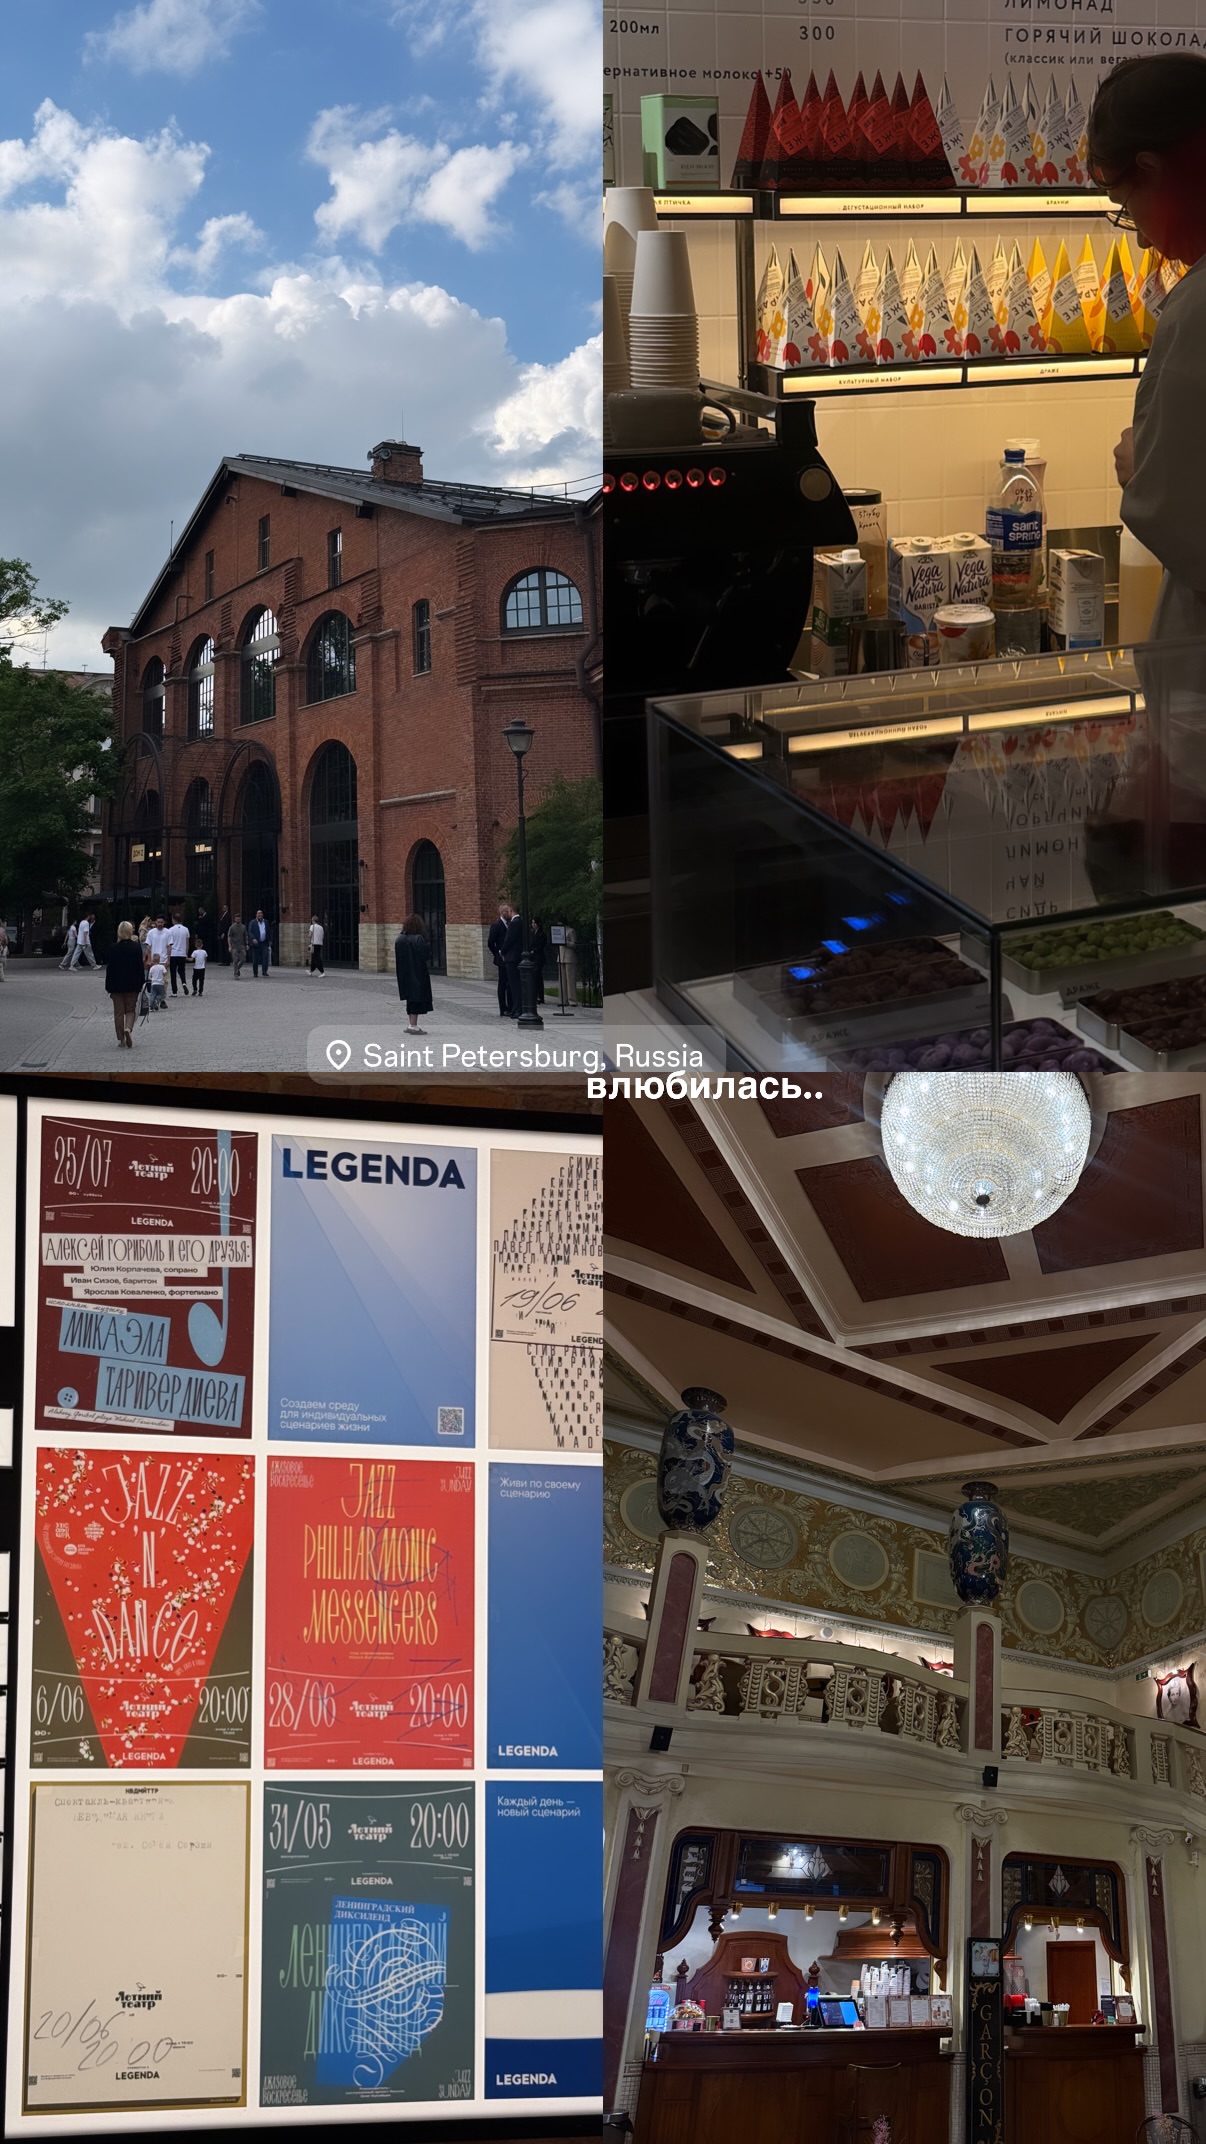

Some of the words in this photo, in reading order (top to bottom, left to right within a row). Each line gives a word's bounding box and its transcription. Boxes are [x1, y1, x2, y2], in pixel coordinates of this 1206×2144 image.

[610, 20, 659, 34] 200мл
[799, 26, 835, 40] 300
[1005, 27, 1101, 44] ГОРЯЧИЙ
[1112, 31, 1206, 46] ШОКОЛА
[1005, 52, 1064, 65] (классик
[1070, 56, 1094, 64] или
[603, 67, 697, 80] ернативное
[1008, 531, 1041, 542] SPRING
[911, 563, 943, 582] Vega
[956, 558, 988, 579] Vega
[905, 579, 947, 604] Natura
[952, 575, 992, 600] Natura
[914, 602, 940, 610] BARISTA
[54, 1134, 113, 1189] 25/07
[128, 1160, 174, 1173] Летний
[134, 1171, 168, 1181] театр
[191, 1147, 240, 1197] 20:00
[283, 1148, 466, 1190] LEGENDA
[131, 1217, 174, 1228] LEGENDA
[494, 1240, 531, 1254] ПАВЕЛ
[540, 1241, 603, 1257] КАРМАНОВ
[116, 1266, 162, 1274] Корпачева,
[164, 1267, 198, 1275] сопрано
[94, 1277, 121, 1285] Сизов,
[123, 1277, 157, 1285] баритон
[84, 1289, 119, 1297] Ярослав
[120, 1289, 167, 1297] Коваленко,
[168, 1289, 218, 1297] фортепиано
[500, 1281, 580, 1318] 19/06
[63, 1311, 165, 1358] МИКАЭЛА
[106, 1366, 239, 1422] ТАРИВЕРДИЕВА
[280, 1397, 326, 1410] Создаем
[329, 1401, 360, 1412] среду
[280, 1410, 299, 1419] для
[301, 1411, 388, 1423] индивидуальных
[280, 1420, 336, 1431] сценариев
[337, 1423, 370, 1432] жизни
[341, 1463, 396, 1519] JAZZ
[500, 1477, 528, 1488] Живи
[530, 1479, 542, 1489] по
[545, 1479, 581, 1491] своему
[101, 1462, 193, 1524] JAZZ
[500, 1489, 551, 1499] сценарию
[303, 1523, 439, 1583] PHILHARMONIC
[303, 1588, 439, 1646] MESSENGERS
[92, 1599, 199, 1664] DANCE
[36, 1682, 84, 1726] 6/06
[199, 1686, 249, 1724] 20:00
[269, 1679, 336, 1731] 28/06
[350, 1701, 394, 1712] Летний
[409, 1682, 468, 1729] 20:00
[126, 1709, 160, 1720] театр
[355, 1710, 388, 1720] театр
[122, 1752, 166, 1761] LEGENDA
[498, 1745, 558, 1757] LEGENDA
[352, 1757, 394, 1766] LEGENDA
[497, 1796, 538, 1807] Каждый
[540, 1797, 564, 1807] день
[497, 1807, 529, 1817] новый
[532, 1806, 581, 1818] сценарий
[269, 1800, 331, 1853] 31/05
[348, 1824, 393, 1835] Летний
[410, 1802, 470, 1849] 20:00
[354, 1833, 387, 1843] театр
[351, 1877, 393, 1886] LEGENDA
[335, 1900, 415, 1914] ЛЕНИНГРАДСКИЙ
[334, 1910, 391, 1922] ДИКСИЛЕНД
[115, 1990, 162, 2002] Летний
[121, 2000, 156, 2010] театр
[34, 1999, 125, 2048] 20/06
[979, 2004, 993, 2127] GARÇON
[115, 2071, 160, 2080] LEGENDA
[496, 2073, 557, 2086] LEGENDA
